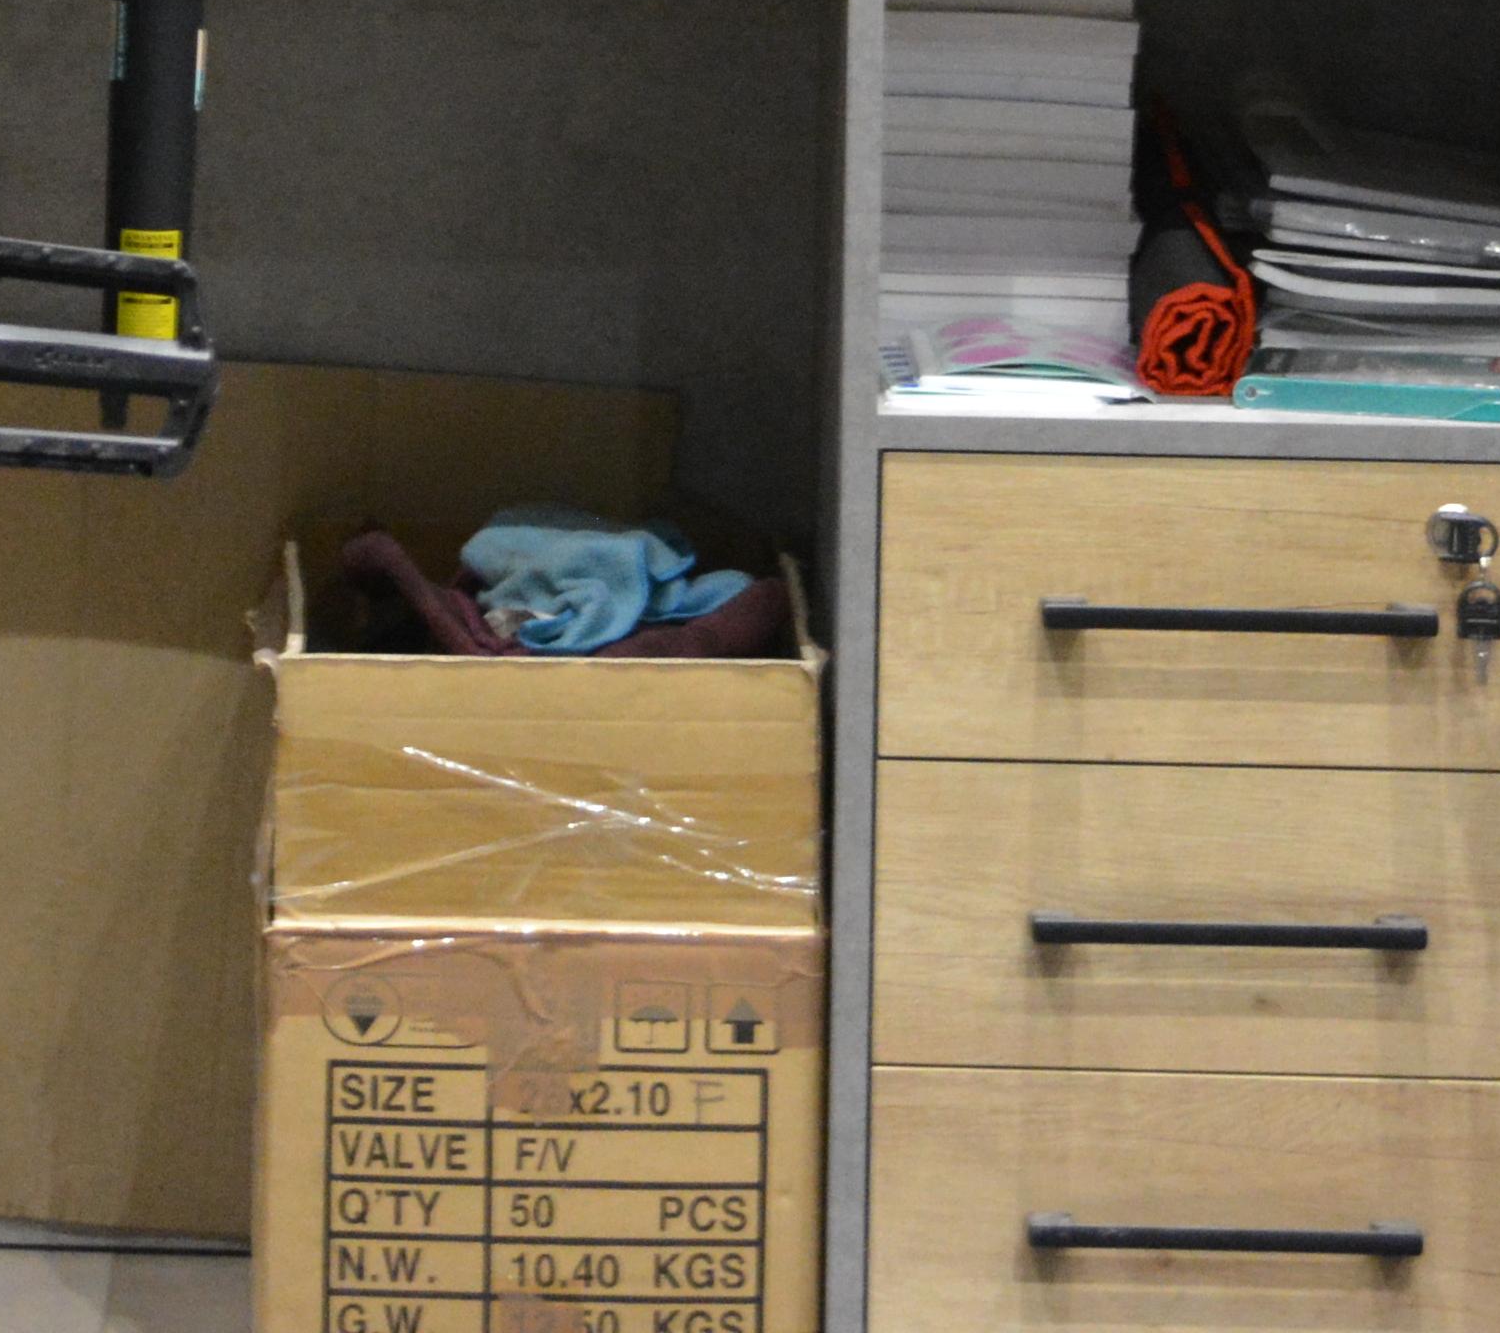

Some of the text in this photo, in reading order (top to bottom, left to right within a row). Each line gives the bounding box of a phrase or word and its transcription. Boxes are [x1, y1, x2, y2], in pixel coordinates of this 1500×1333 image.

[340, 1074, 436, 1113] SIZE
[339, 1130, 468, 1172] VALVE
[514, 1136, 576, 1174] F/V
[338, 1188, 441, 1227] Q'TY
[510, 1193, 748, 1233] 50 PCS
[337, 1245, 438, 1284] N.W.
[510, 1252, 746, 1290] 10.40 KGS
[336, 1303, 424, 1333] GW
[652, 1309, 744, 1333] KGS
